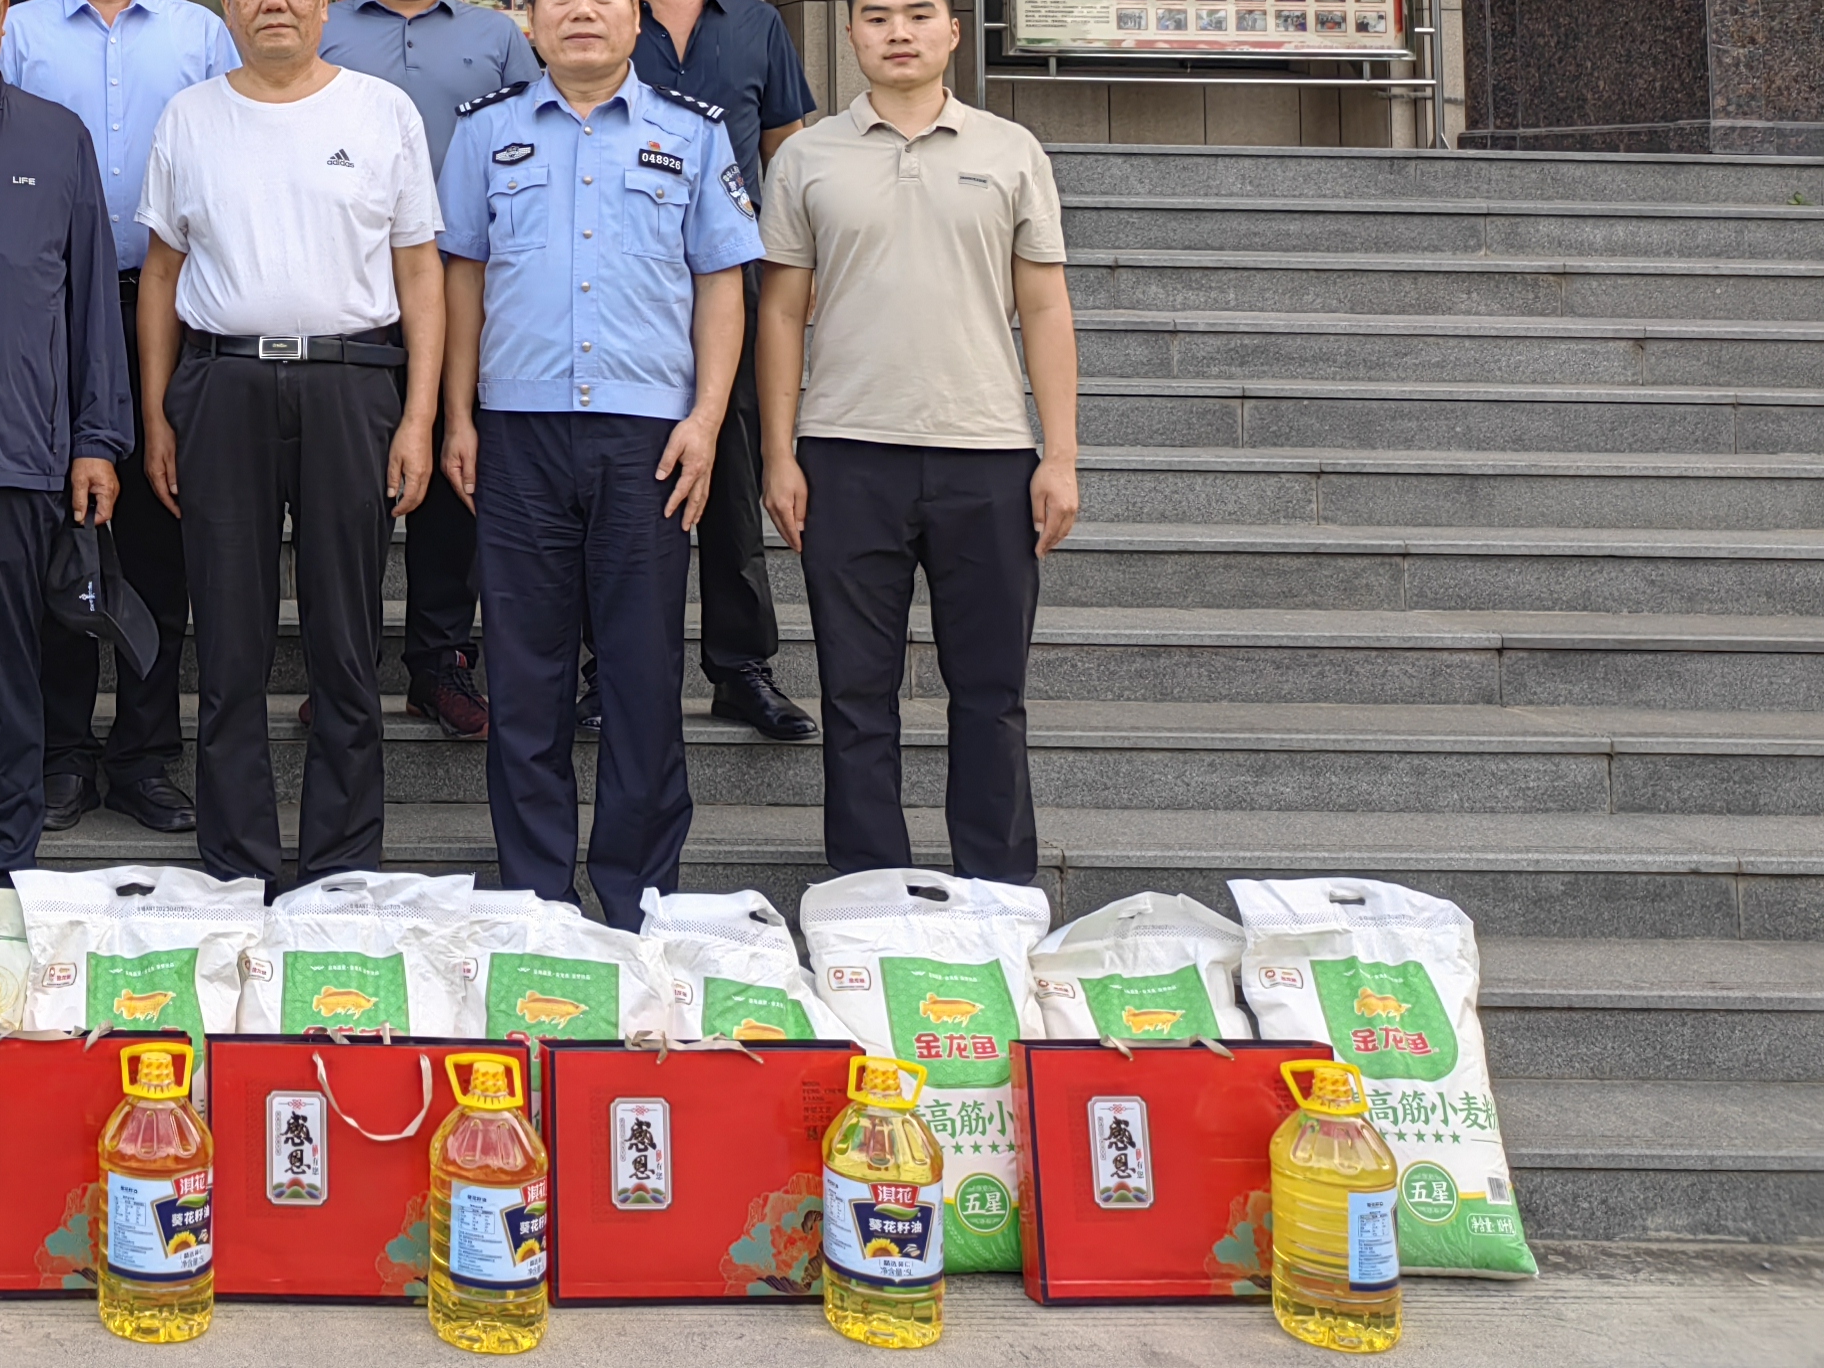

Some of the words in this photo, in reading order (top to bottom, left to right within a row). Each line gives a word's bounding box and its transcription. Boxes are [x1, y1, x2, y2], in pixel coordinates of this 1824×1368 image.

[326, 159, 355, 169] adidas
[641, 152, 682, 170] 048926
[914, 1032, 1000, 1061] 金龙鱼
[1351, 1026, 1433, 1057] 金龙鱼
[914, 1099, 1015, 1139] 高筋小
[1352, 1088, 1498, 1131] 高筋小麦粉
[279, 1111, 313, 1175] 感恩
[623, 1115, 657, 1180] 感恩
[1103, 1115, 1136, 1179] 感恩
[179, 1173, 205, 1194] 淇花
[877, 1185, 913, 1203] 淇花
[1410, 1181, 1454, 1205] 五星
[171, 1204, 210, 1227] 葵花籽油
[962, 1192, 1007, 1215] 五星
[868, 1217, 923, 1234] 葵花籽油
